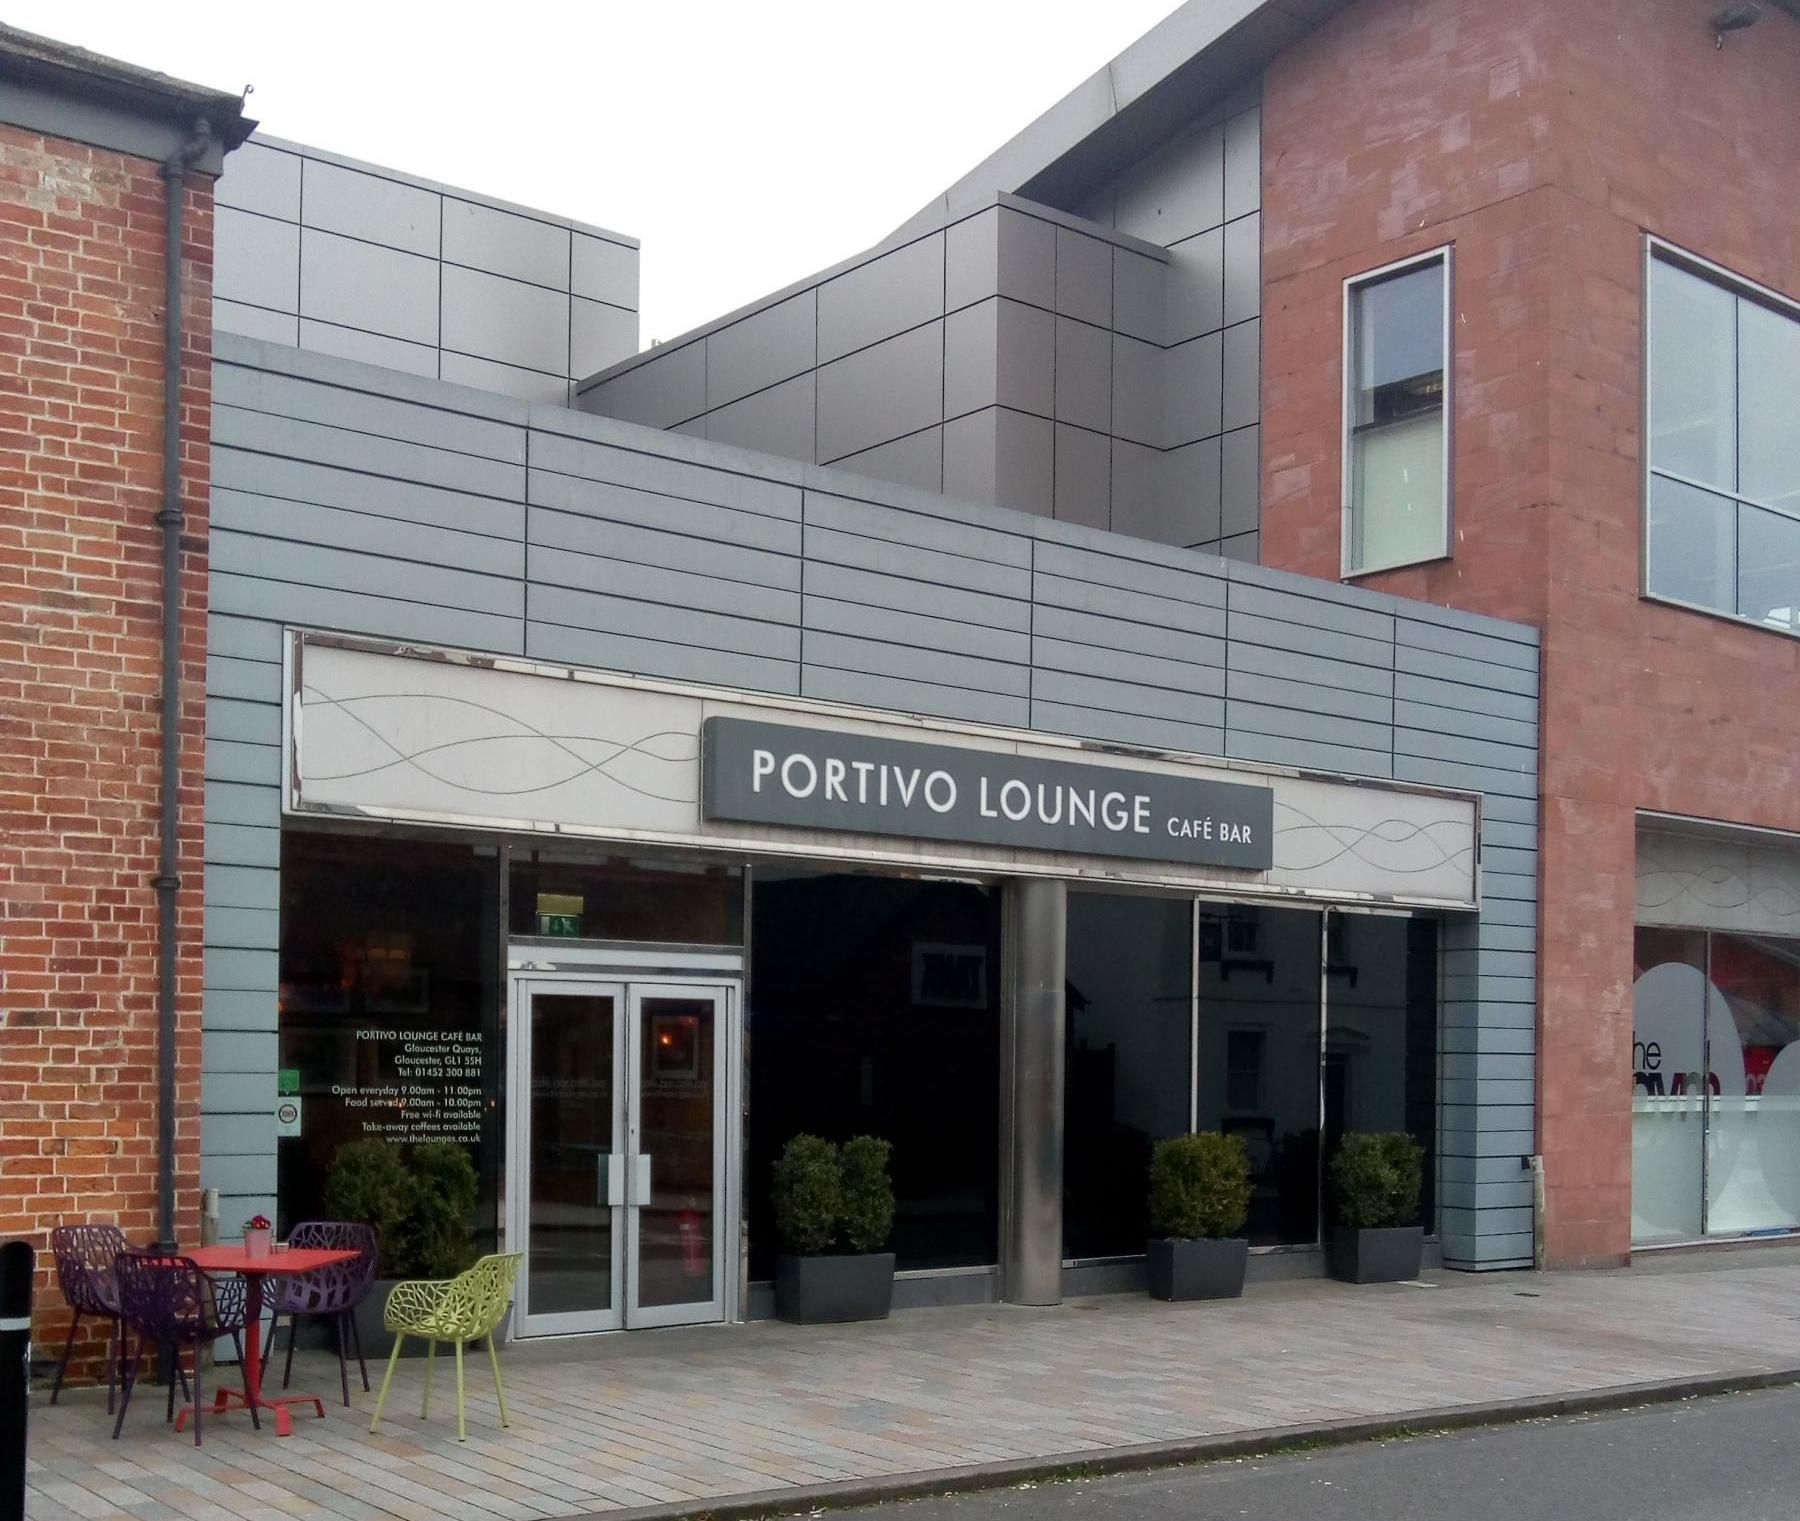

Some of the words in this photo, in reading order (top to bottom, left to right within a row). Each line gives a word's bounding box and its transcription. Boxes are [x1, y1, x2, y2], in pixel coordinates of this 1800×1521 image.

[752, 748, 958, 814] PORTIVO
[979, 776, 1152, 835] LOUNGE
[1166, 816, 1213, 840] CAFÉ
[1219, 822, 1253, 845] BAR
[356, 1030, 397, 1041] PORTIVO
[399, 1031, 439, 1041] LOUNGE
[465, 1032, 482, 1042] BAR
[404, 1043, 450, 1053] Gloucester
[452, 1043, 482, 1056] Quays,
[1632, 1030, 1661, 1070] he
[394, 1055, 442, 1066] Gloucester,
[444, 1056, 461, 1066] GL1
[398, 1067, 413, 1077] Tel:
[415, 1067, 443, 1077] 01452
[446, 1068, 463, 1078] 300
[465, 1068, 481, 1078] 881
[331, 1085, 358, 1097] Open
[359, 1086, 399, 1097] everyday
[401, 1086, 435, 1096] 9.00am
[444, 1086, 482, 1098] 11.00pm
[345, 1097, 368, 1108] Food
[370, 1098, 398, 1108] served
[401, 1098, 435, 1108] 9.00am
[444, 1098, 482, 1109] 10.00pm
[401, 1109, 420, 1119] Free
[422, 1109, 441, 1119] wi-fi
[443, 1109, 481, 1119] available
[362, 1121, 409, 1133] Take-away
[411, 1121, 441, 1131] coffees
[443, 1122, 481, 1131] available
[385, 1133, 481, 1146] www.thelounges.co.uk
